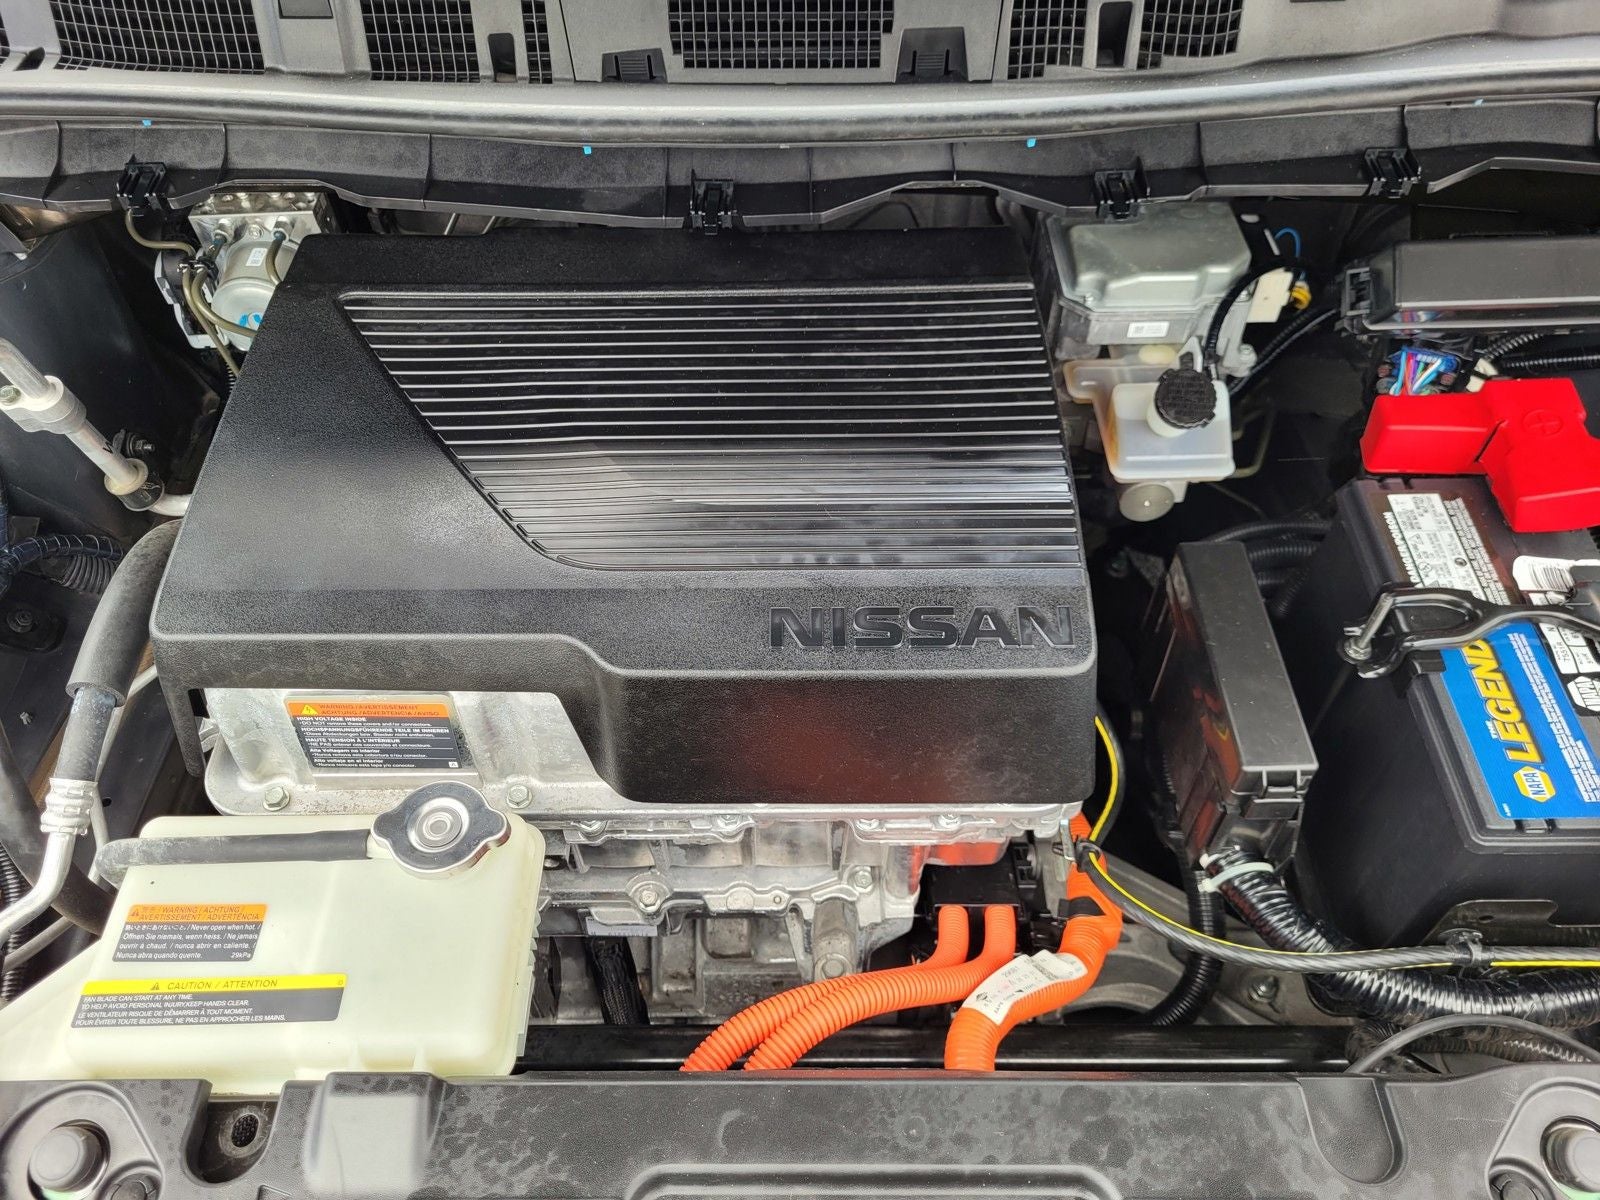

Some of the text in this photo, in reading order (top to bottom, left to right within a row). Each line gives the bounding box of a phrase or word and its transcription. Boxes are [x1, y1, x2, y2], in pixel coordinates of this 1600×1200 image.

[770, 605, 1075, 649] NISSAN
[1461, 639, 1544, 764] LEGEND
[1521, 772, 1546, 796] NAPA
[237, 933, 258, 941] jamais
[153, 952, 178, 960] quando
[167, 981, 211, 990] CAUTION
[222, 979, 278, 989] ATTENTION
